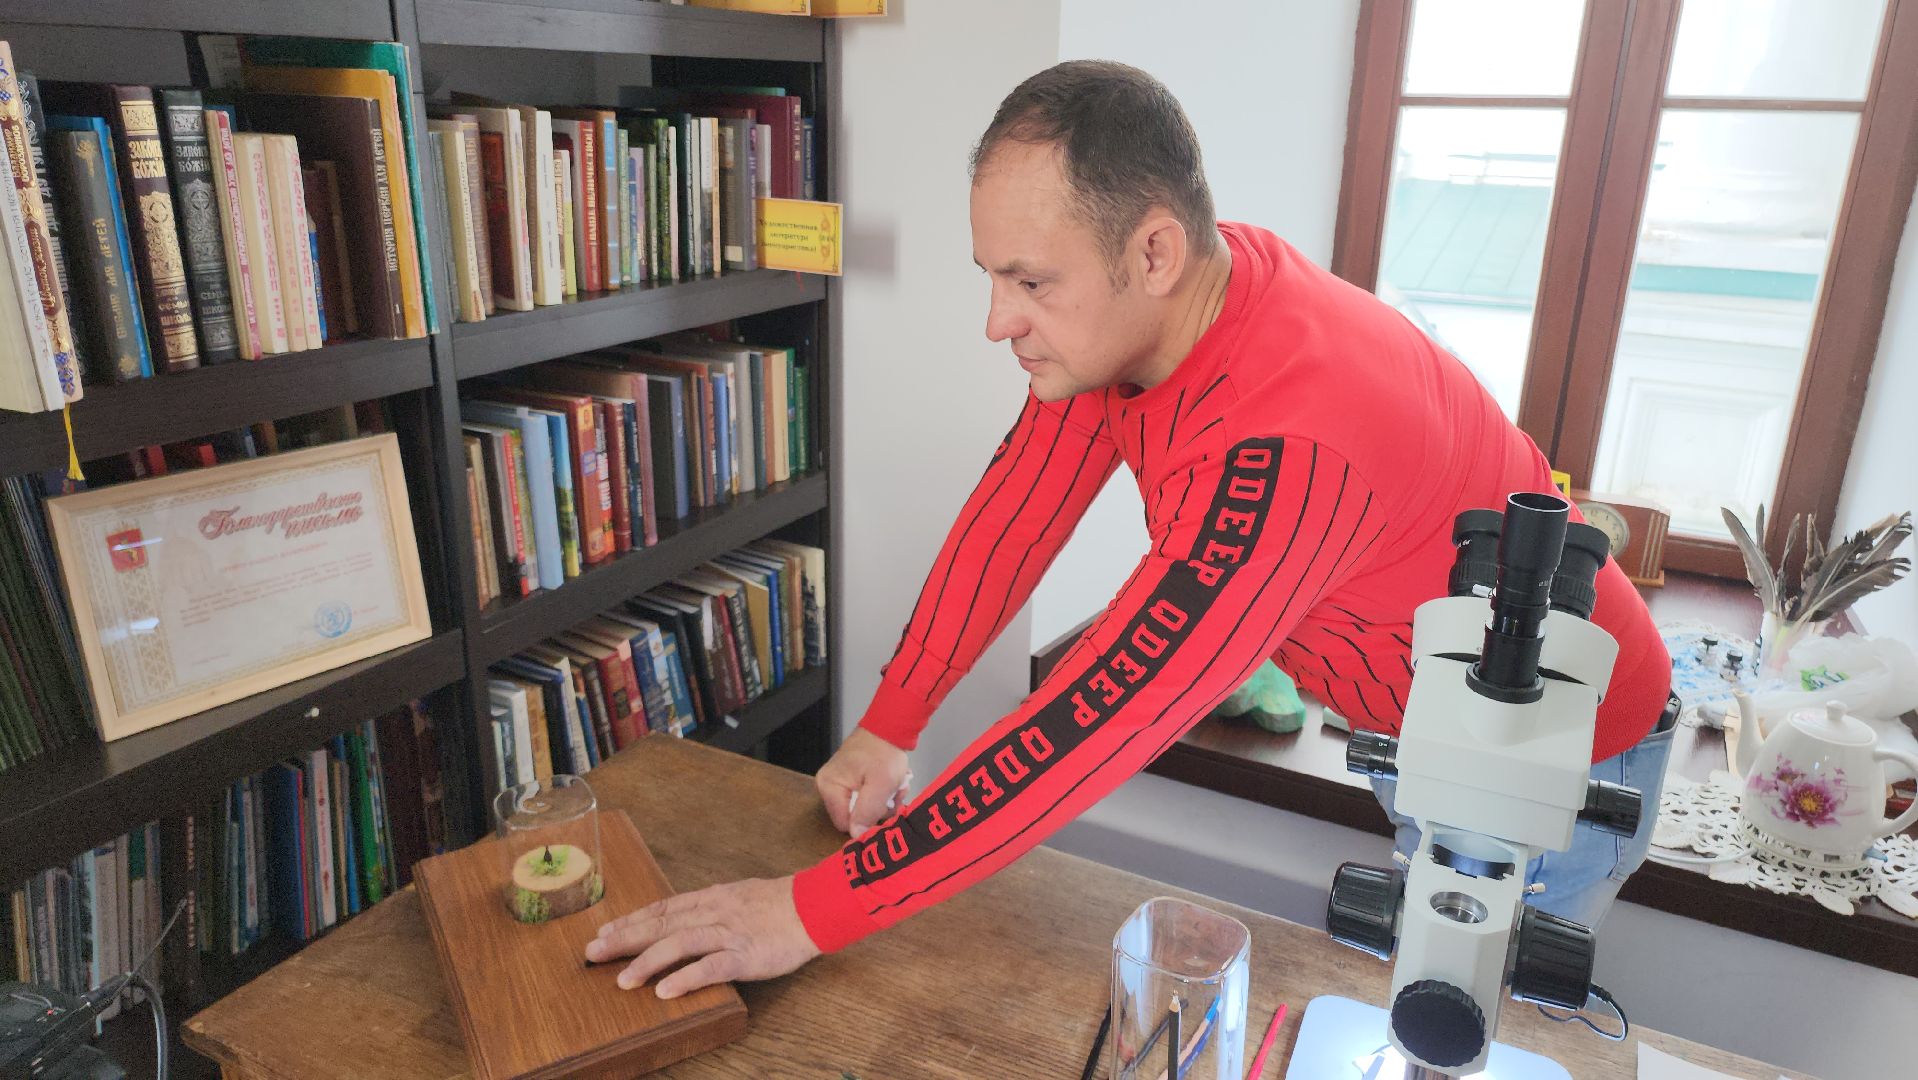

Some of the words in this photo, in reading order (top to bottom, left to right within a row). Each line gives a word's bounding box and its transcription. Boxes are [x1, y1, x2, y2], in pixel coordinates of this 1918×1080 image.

[1187, 447, 1272, 588] QDEEP
[1073, 598, 1190, 729] QDEEP
[927, 726, 1055, 841] QDEEP
